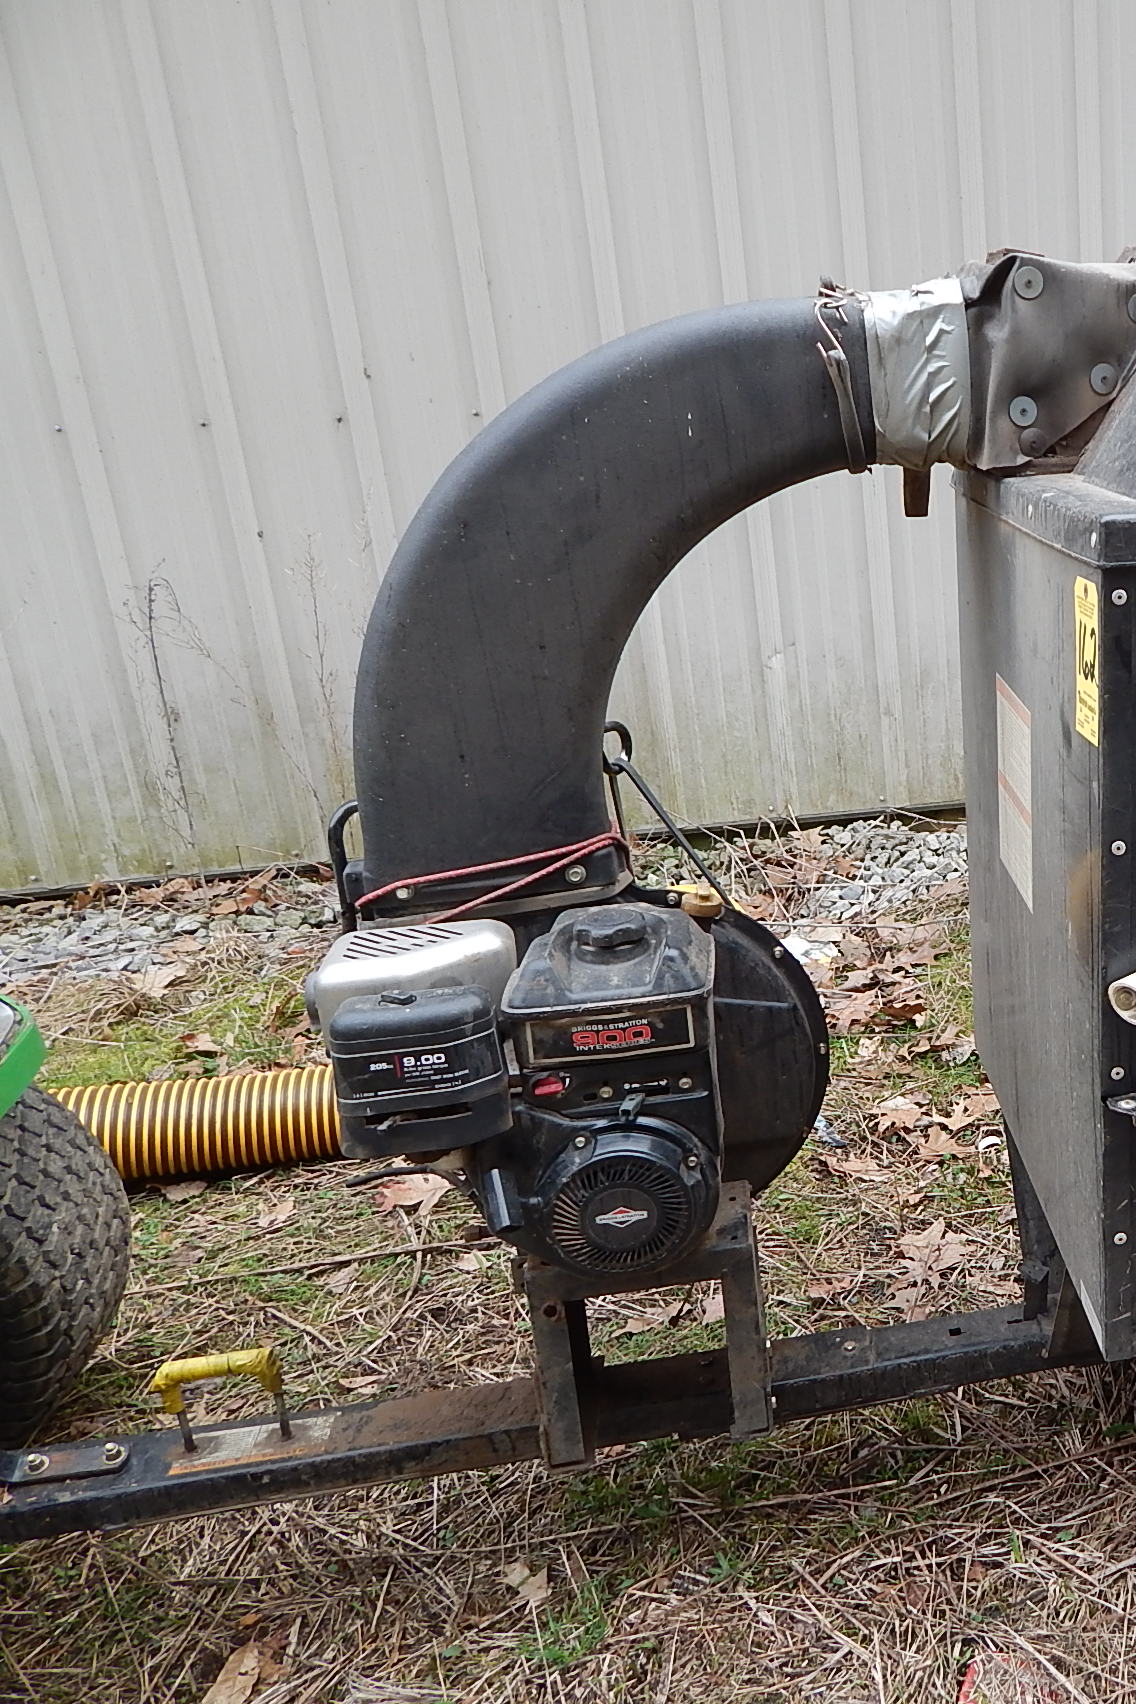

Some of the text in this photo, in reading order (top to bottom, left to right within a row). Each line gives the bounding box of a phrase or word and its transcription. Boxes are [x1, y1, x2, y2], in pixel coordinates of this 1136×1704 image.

[609, 1018, 648, 1030] STRATTON
[573, 1025, 652, 1047] 900
[402, 1053, 446, 1067] 9.00
